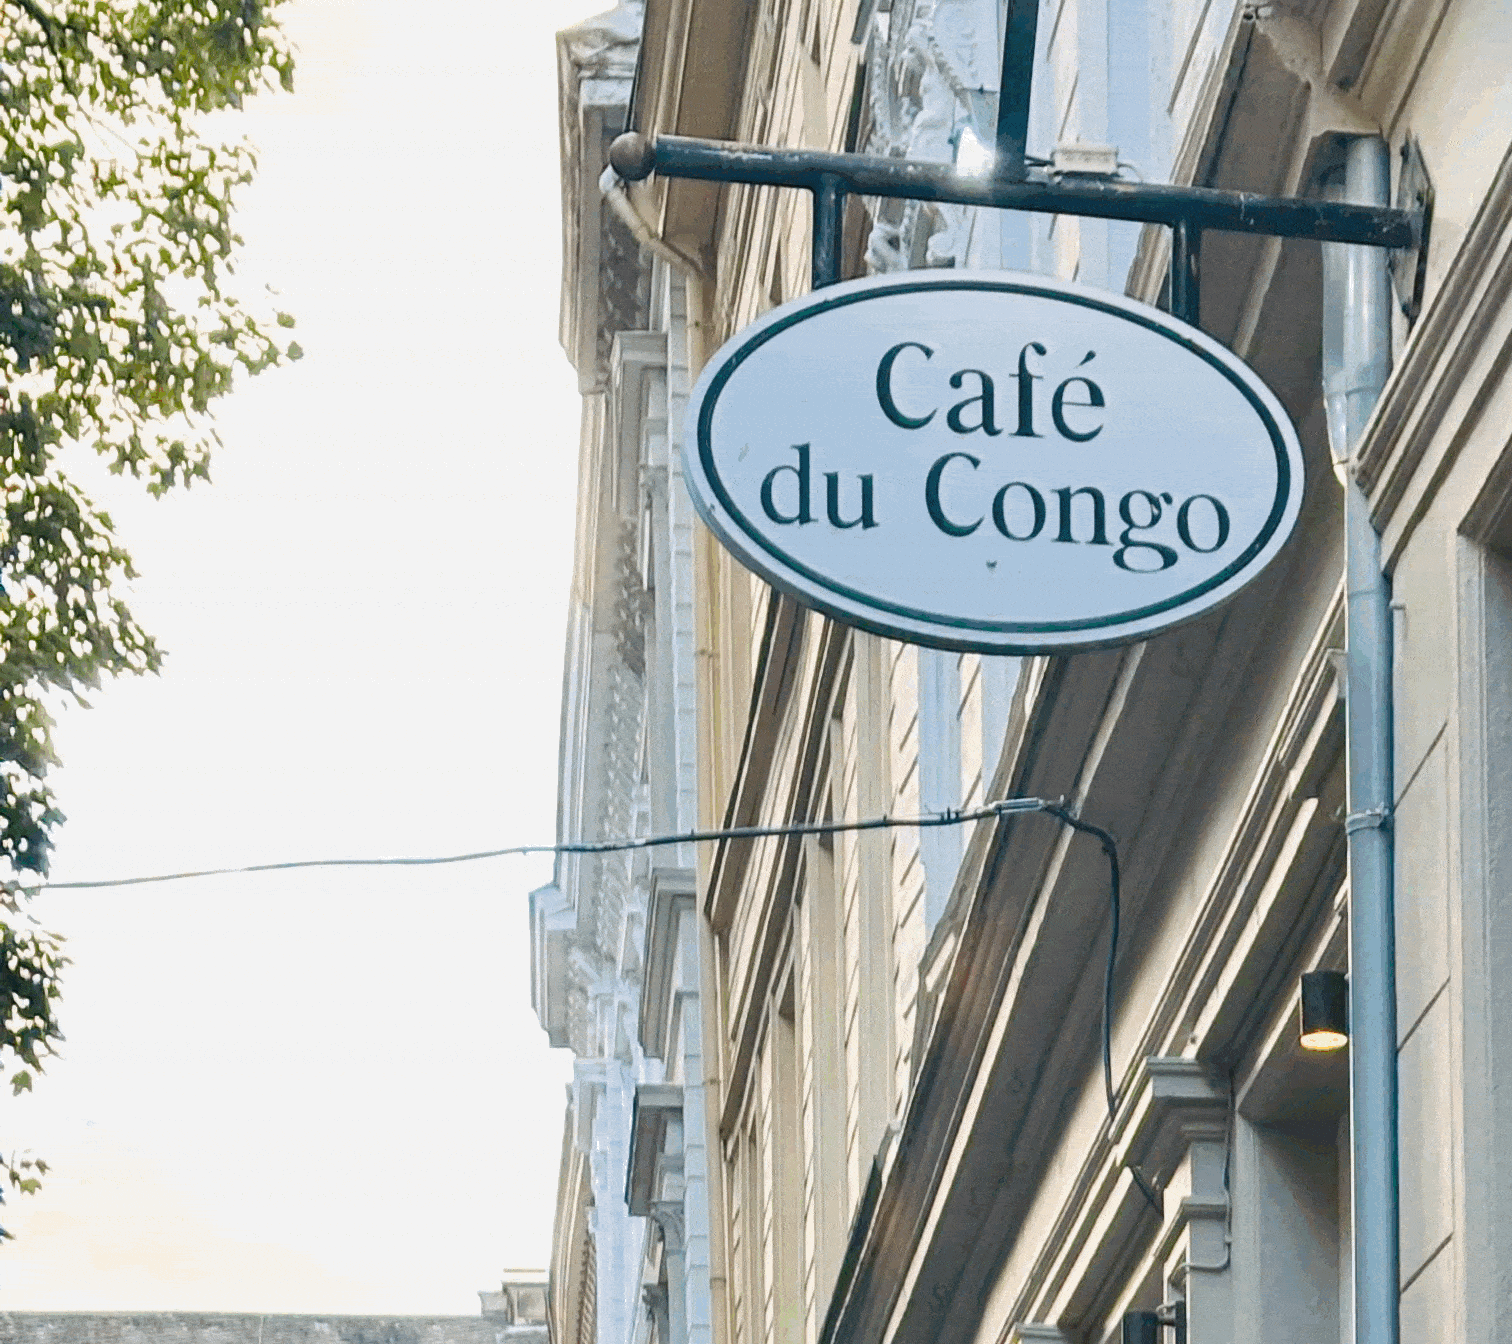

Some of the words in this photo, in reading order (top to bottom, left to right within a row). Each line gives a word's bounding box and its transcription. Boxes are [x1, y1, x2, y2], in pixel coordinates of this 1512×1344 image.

[876, 341, 1105, 443] Café
[760, 442, 879, 531] du
[925, 451, 1231, 573] Congo
